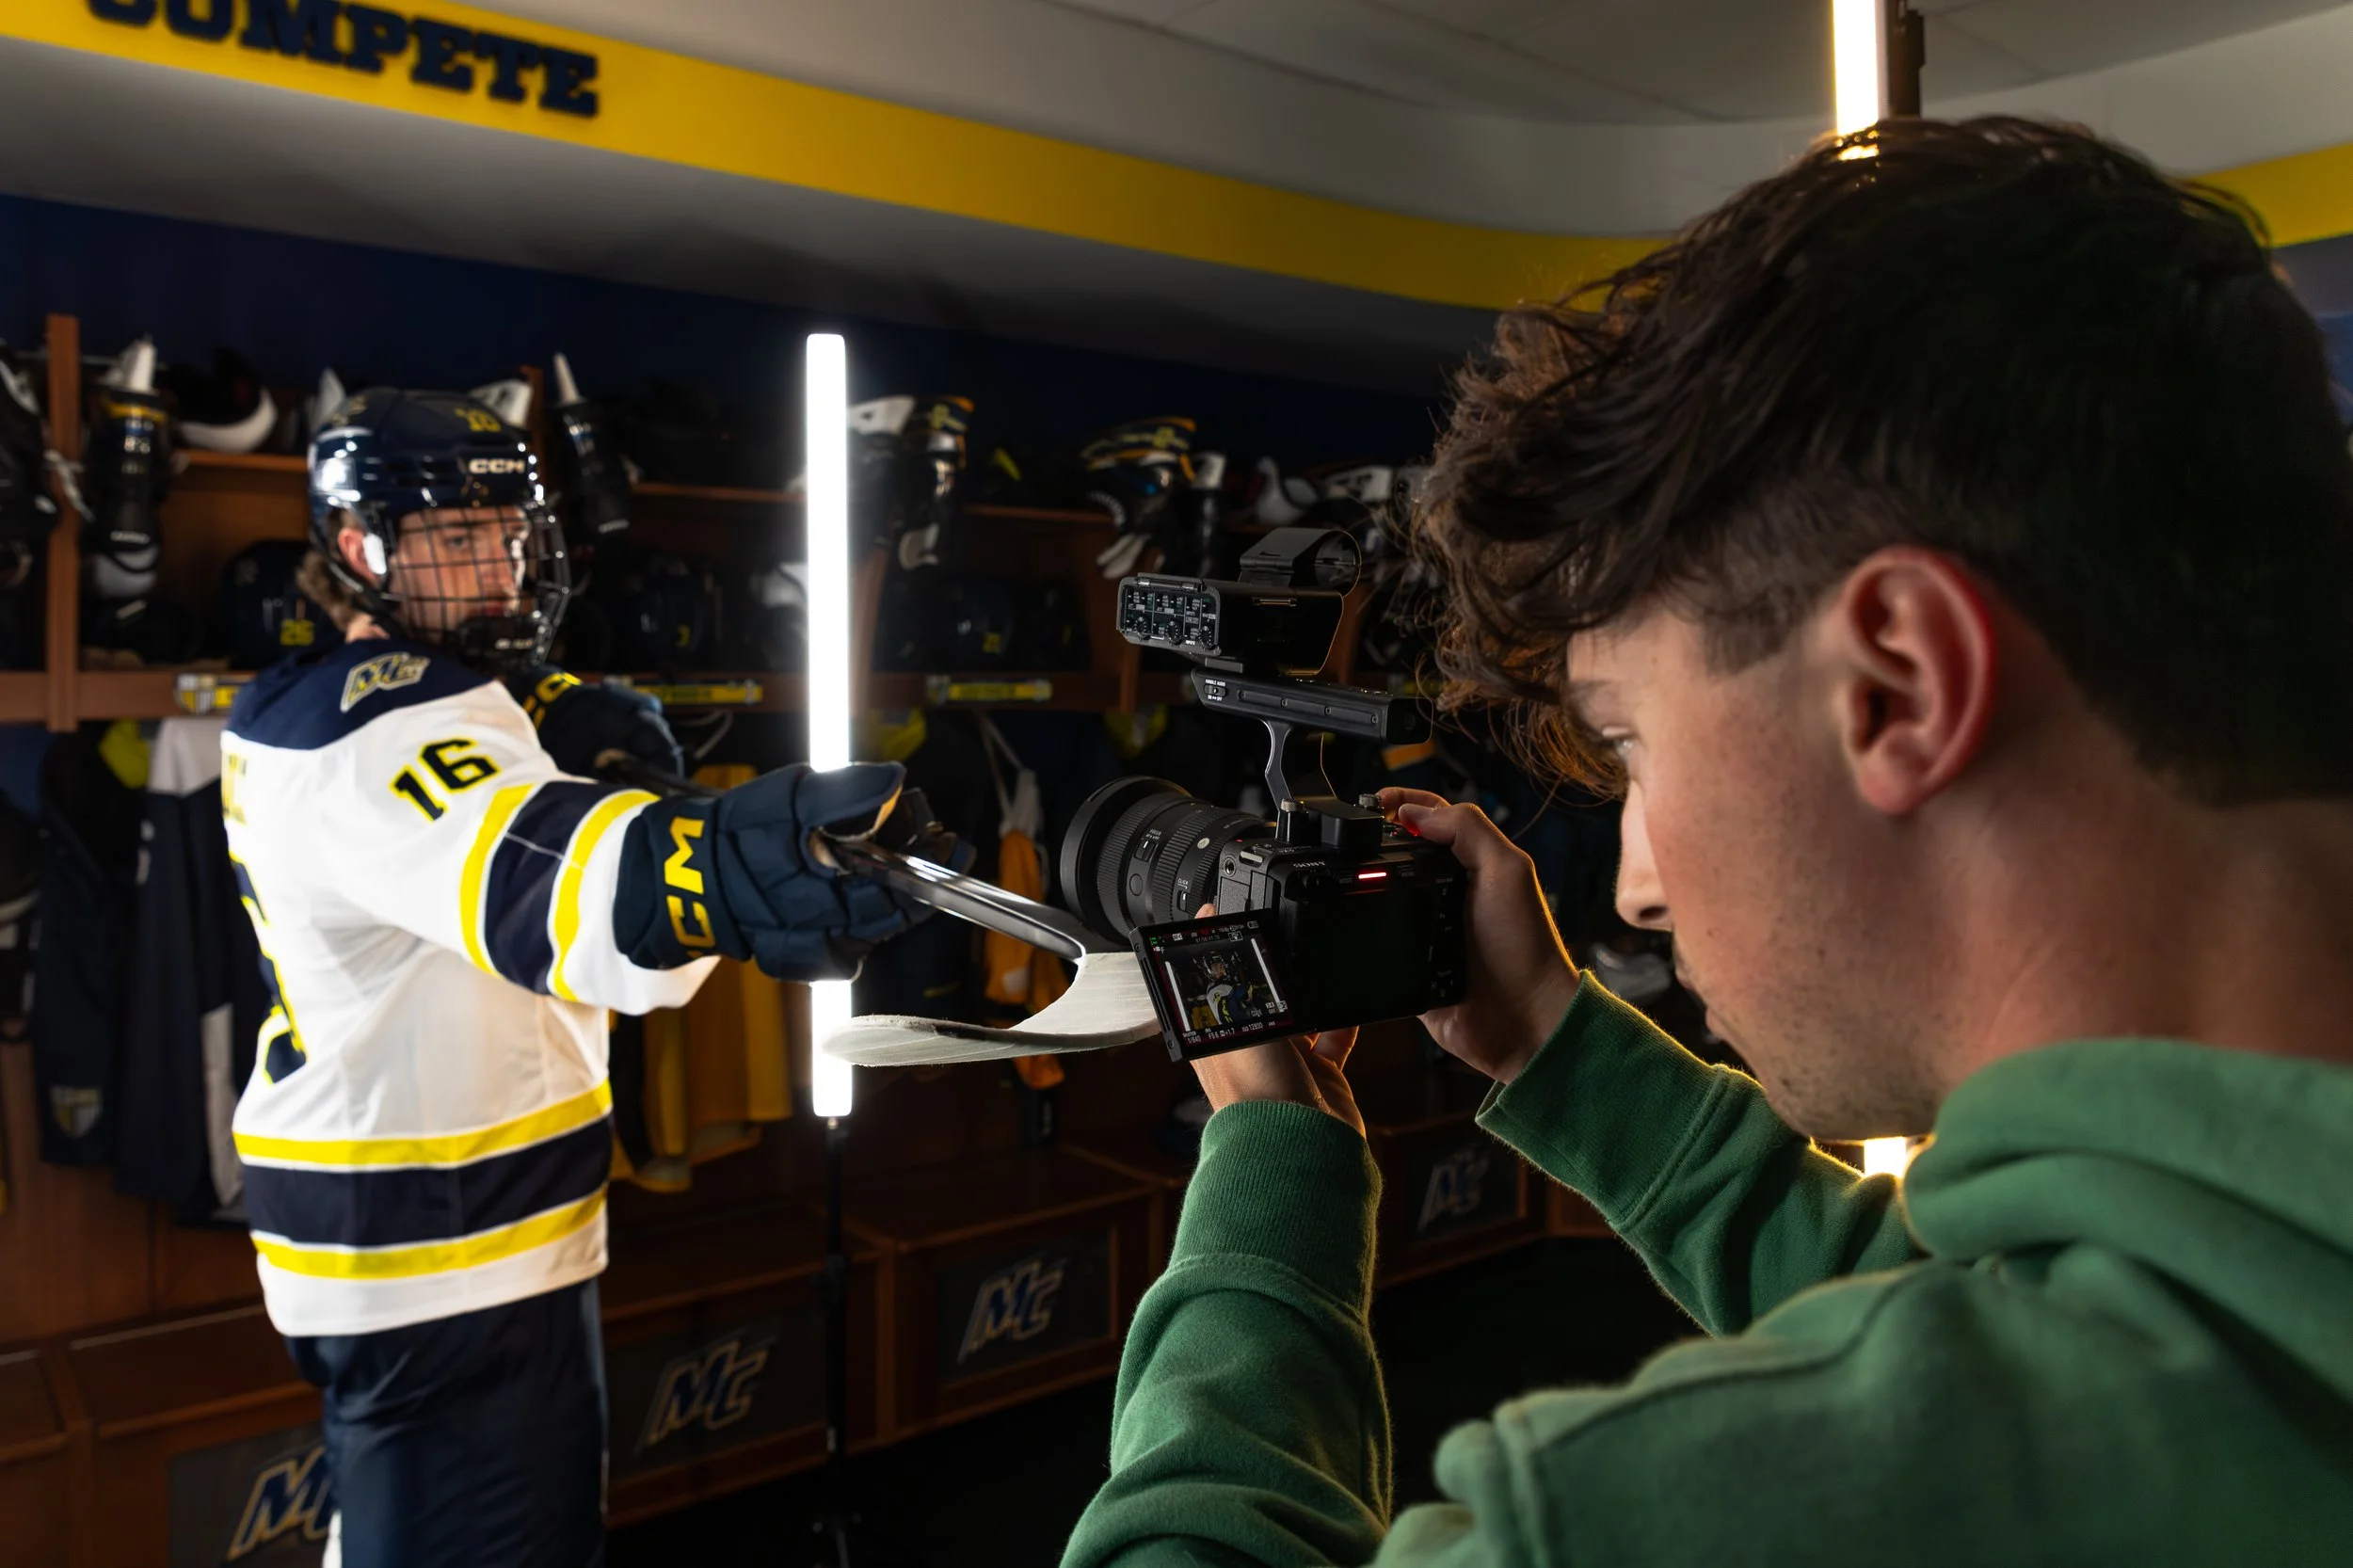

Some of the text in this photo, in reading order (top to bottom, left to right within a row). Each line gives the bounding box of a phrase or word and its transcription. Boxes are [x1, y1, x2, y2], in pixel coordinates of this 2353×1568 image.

[468, 457, 526, 474] CCM
[389, 737, 502, 823] 16
[664, 816, 716, 959] CM
